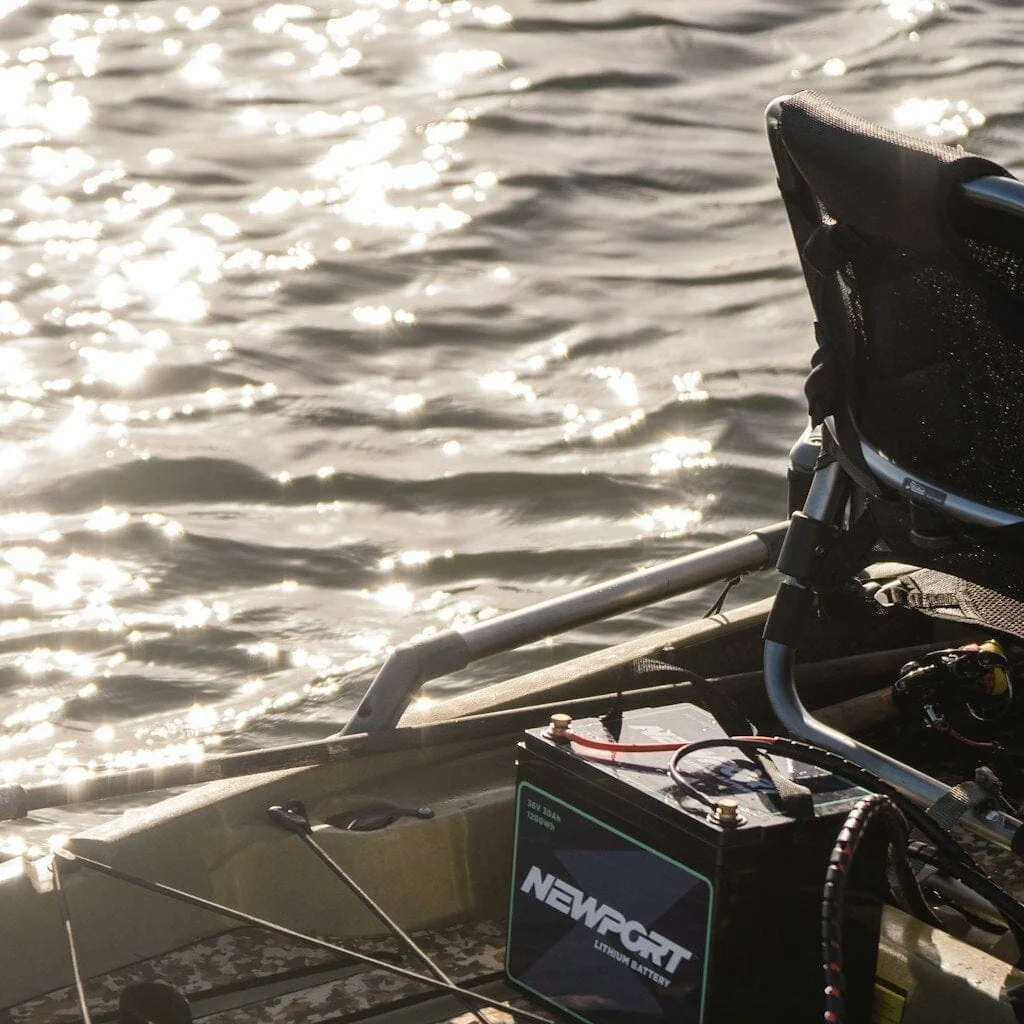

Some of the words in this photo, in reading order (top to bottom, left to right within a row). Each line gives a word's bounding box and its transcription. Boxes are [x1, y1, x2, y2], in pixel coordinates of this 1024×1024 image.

[521, 865, 693, 974] NEWPORT
[594, 939, 631, 967] LITHIUM
[630, 960, 670, 988] BATTERY
